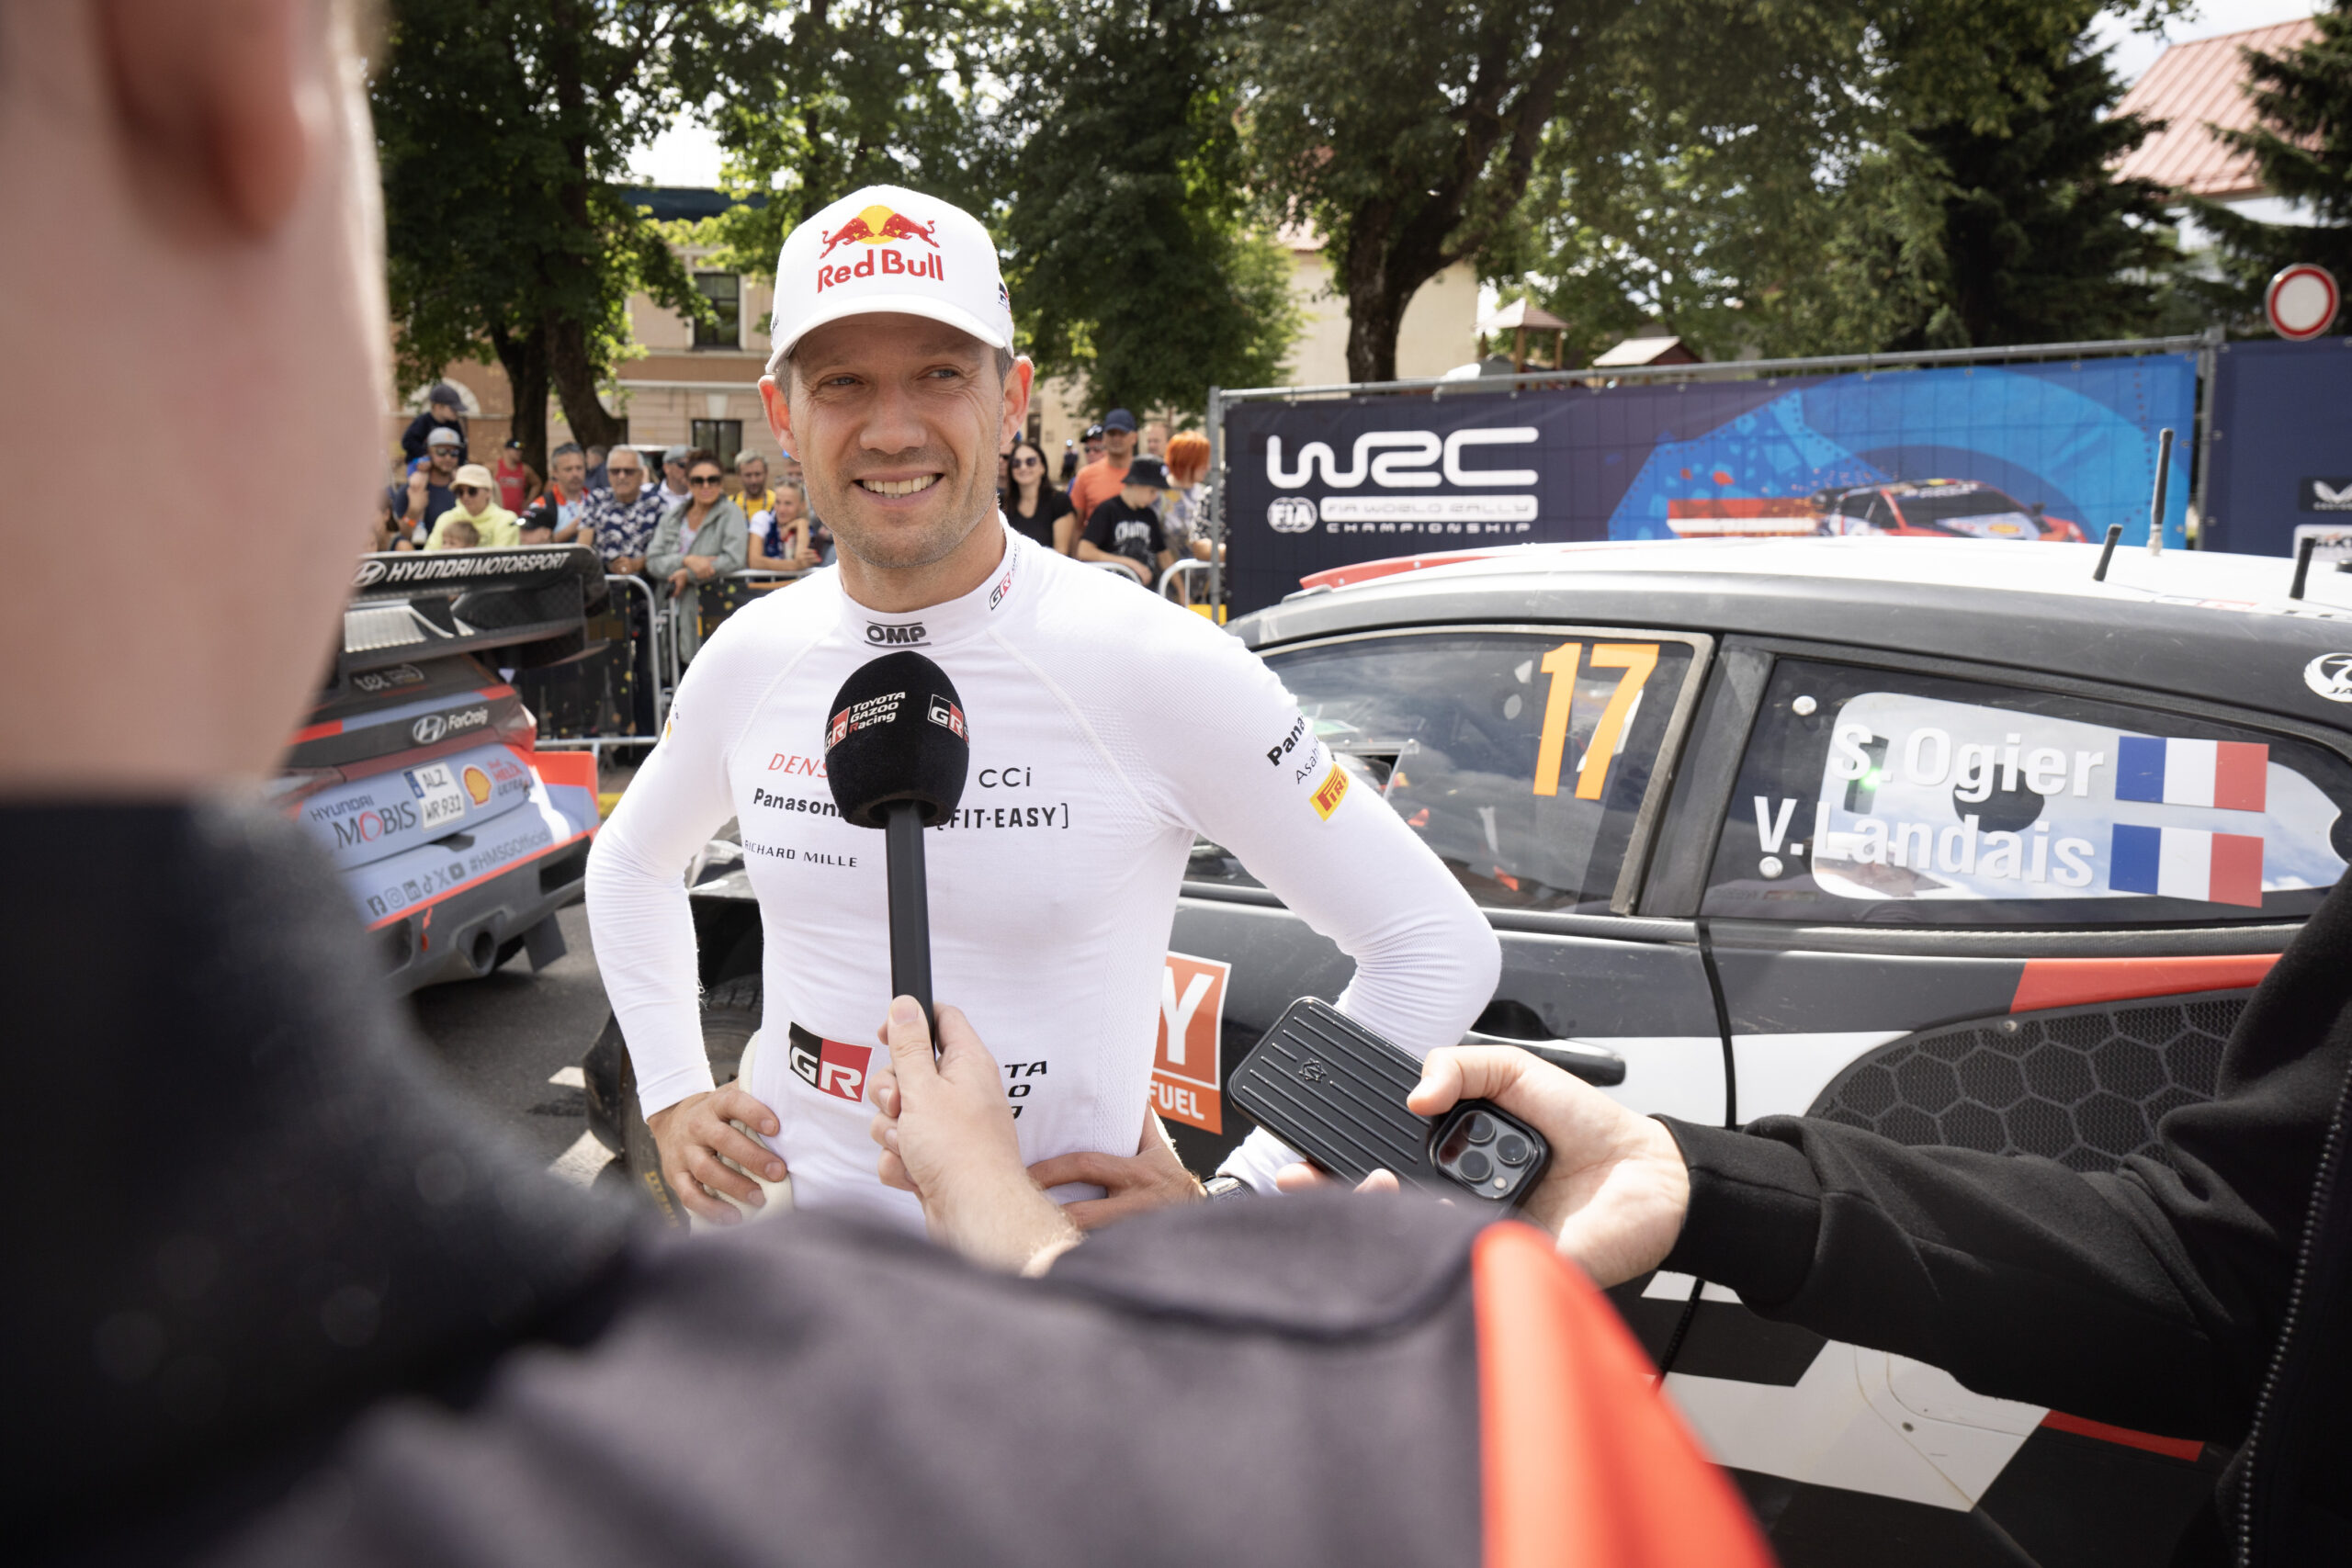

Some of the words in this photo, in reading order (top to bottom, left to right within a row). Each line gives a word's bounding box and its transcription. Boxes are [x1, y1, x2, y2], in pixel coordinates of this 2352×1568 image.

[817, 249, 875, 293] Red
[881, 249, 944, 281] Bull
[1267, 426, 1539, 489] WRC
[1270, 502, 1314, 528] FIA
[1364, 502, 1442, 513] WORLD
[1450, 502, 1531, 513] RALLY
[1326, 522, 1532, 534] CHAMPIONSHIP
[866, 625, 926, 644] OMP
[850, 702, 899, 724] GAZOO
[853, 691, 906, 713] TOYOTA
[848, 712, 897, 734] Racing
[930, 706, 963, 735] GR
[1533, 642, 1660, 800] 17
[1266, 715, 1306, 767] Pana
[768, 752, 829, 778] DENS
[1295, 746, 1320, 785] Asah
[309, 794, 375, 822] HYUNDAI
[441, 794, 462, 817] 931
[753, 787, 843, 818] Panason
[332, 800, 417, 849] MOBIS
[744, 840, 796, 860] RICHARD
[803, 852, 858, 868] MILLE
[1161, 965, 1216, 1066] Y
[790, 1045, 863, 1100] GR
[1004, 1060, 1047, 1078] TA
[1148, 1078, 1205, 1121] FUEL
